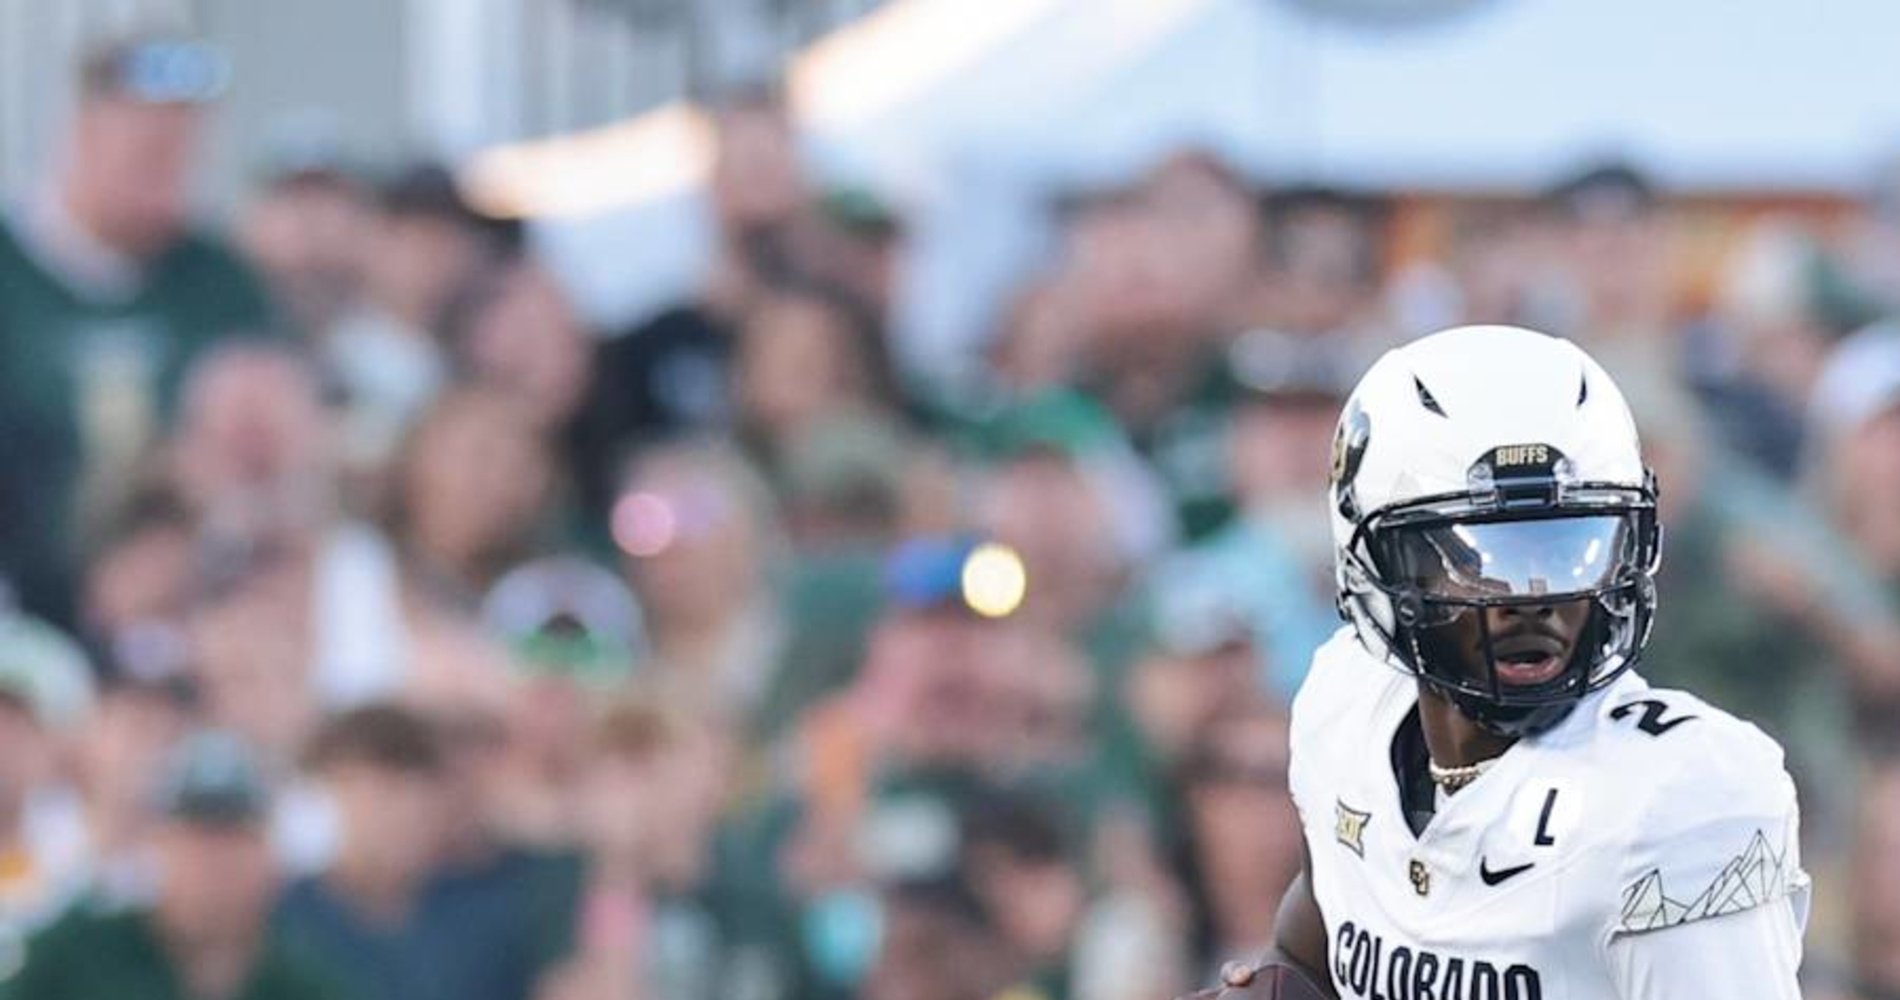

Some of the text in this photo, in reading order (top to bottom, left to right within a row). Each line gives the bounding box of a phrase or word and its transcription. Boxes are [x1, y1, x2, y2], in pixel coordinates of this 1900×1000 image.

[1496, 446, 1548, 466] BUFFS
[1610, 700, 1699, 737] 2
[1534, 788, 1558, 846] L
